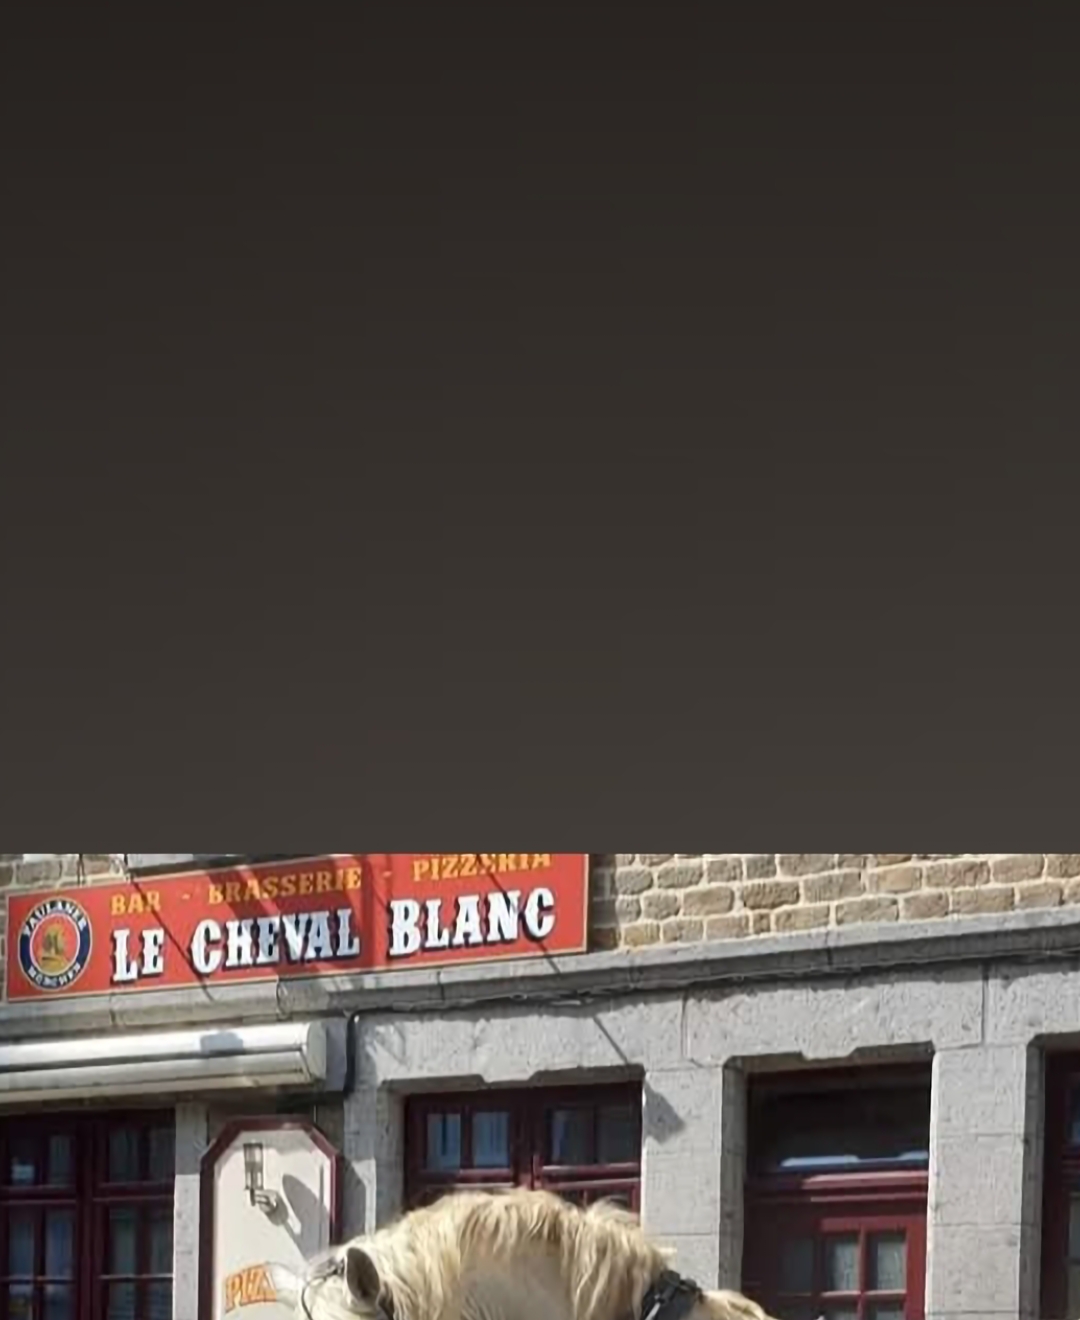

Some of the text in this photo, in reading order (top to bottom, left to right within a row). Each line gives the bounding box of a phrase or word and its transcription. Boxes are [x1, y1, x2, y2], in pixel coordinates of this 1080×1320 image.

[111, 891, 161, 915] BAR
[209, 867, 362, 904] BRASSERIE
[111, 887, 556, 982] LE CHEVAL BLANC
